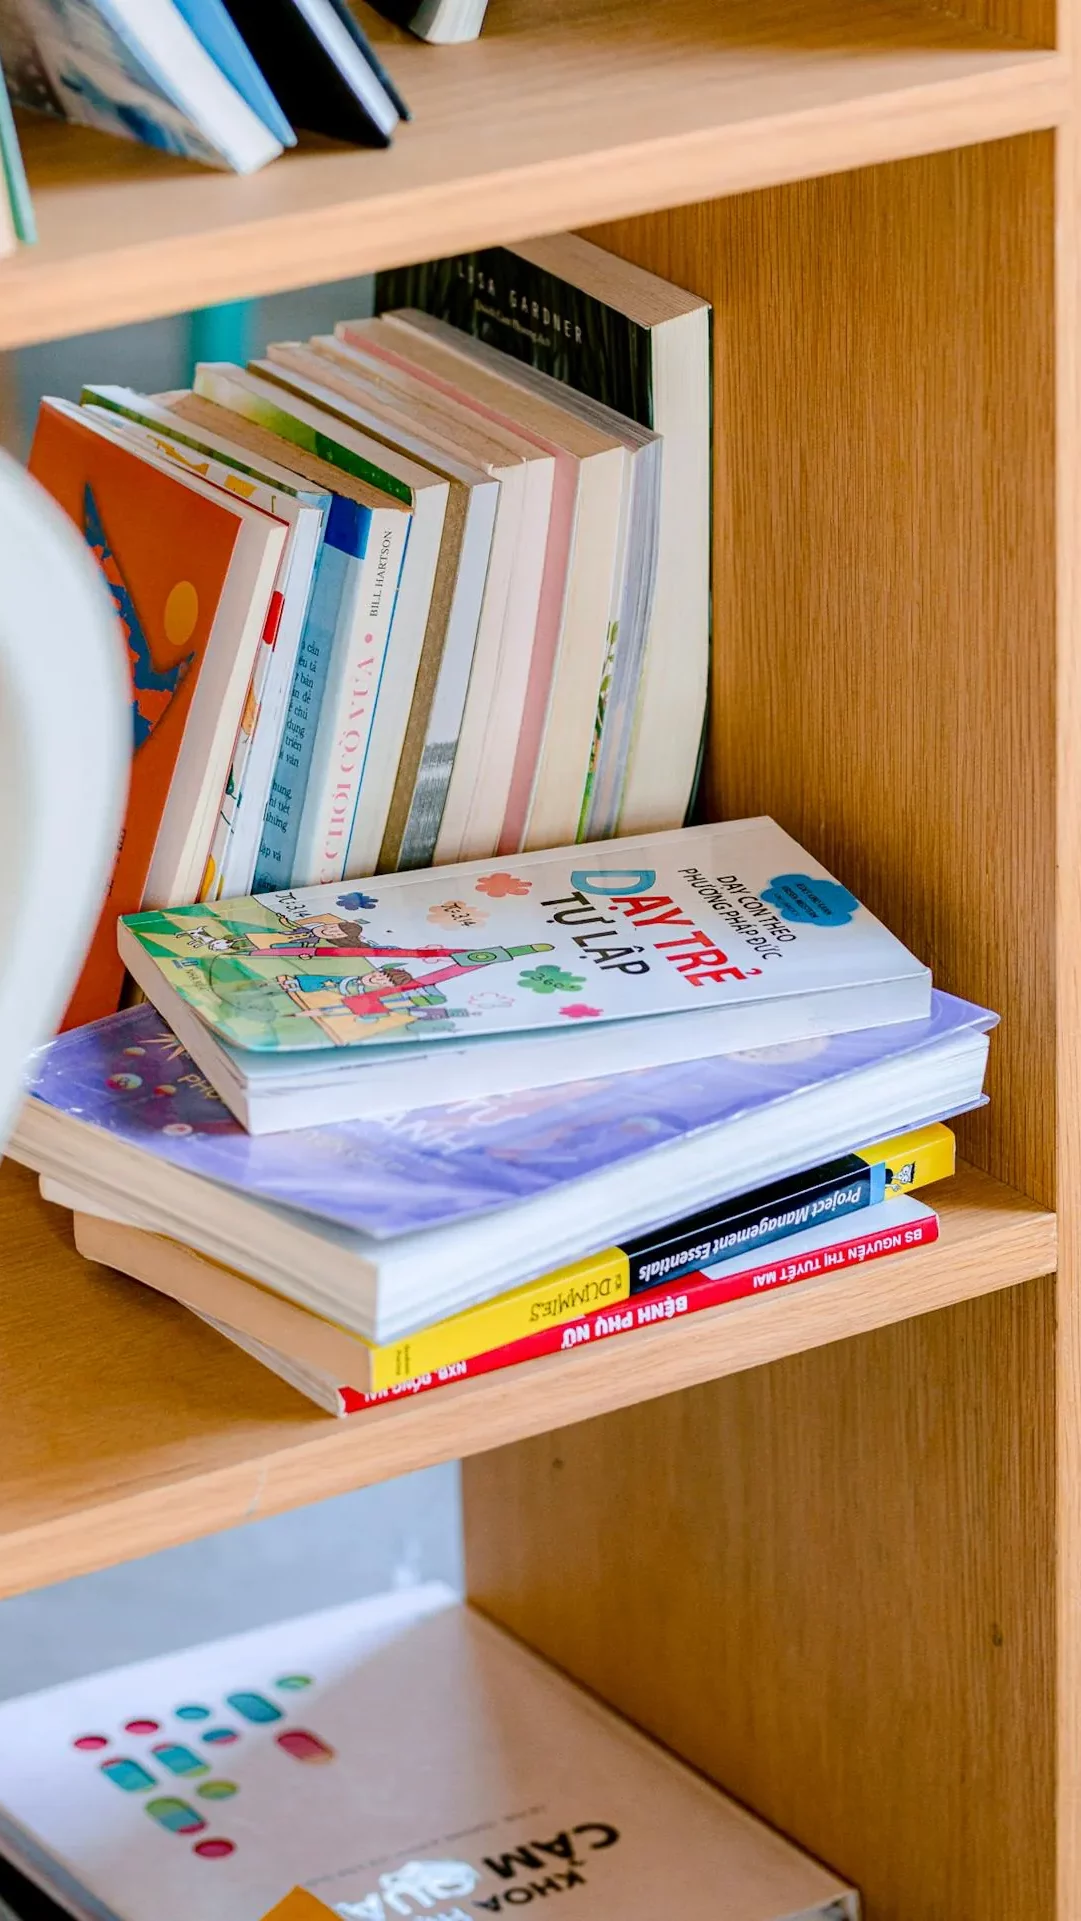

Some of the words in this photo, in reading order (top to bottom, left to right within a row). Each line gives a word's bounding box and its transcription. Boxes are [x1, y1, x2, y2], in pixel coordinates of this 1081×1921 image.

[509, 288, 583, 345] GARDNER
[374, 528, 392, 588] HARTSON
[369, 589, 382, 617] BILL
[541, 891, 616, 925] TỰ
[678, 868, 732, 911] PHƯƠNG
[720, 910, 760, 937] PHÁP
[746, 935, 783, 960] ĐỨC
[717, 875, 750, 894] DẠY
[738, 895, 770, 917] CON
[760, 915, 797, 943] THEO
[571, 870, 695, 927] DẠY
[653, 930, 763, 987] TRẺ
[571, 930, 651, 976] LẬP
[811, 1186, 862, 1217] Project
[711, 1206, 811, 1252] Management
[905, 1229, 923, 1244] BS
[638, 1242, 713, 1282] Essentials
[824, 1249, 846, 1267] THỊ
[848, 1235, 902, 1264] NGUYỄN
[752, 1271, 777, 1289] MAI
[779, 1257, 822, 1282] TUYẾT
[529, 1277, 611, 1323] DUMMIES
[637, 1294, 689, 1326] BỆNH
[560, 1326, 590, 1350] NỮ
[594, 1308, 634, 1336] PHỤ
[482, 1821, 621, 1880] CẢM
[472, 1868, 586, 1913] KHOA
